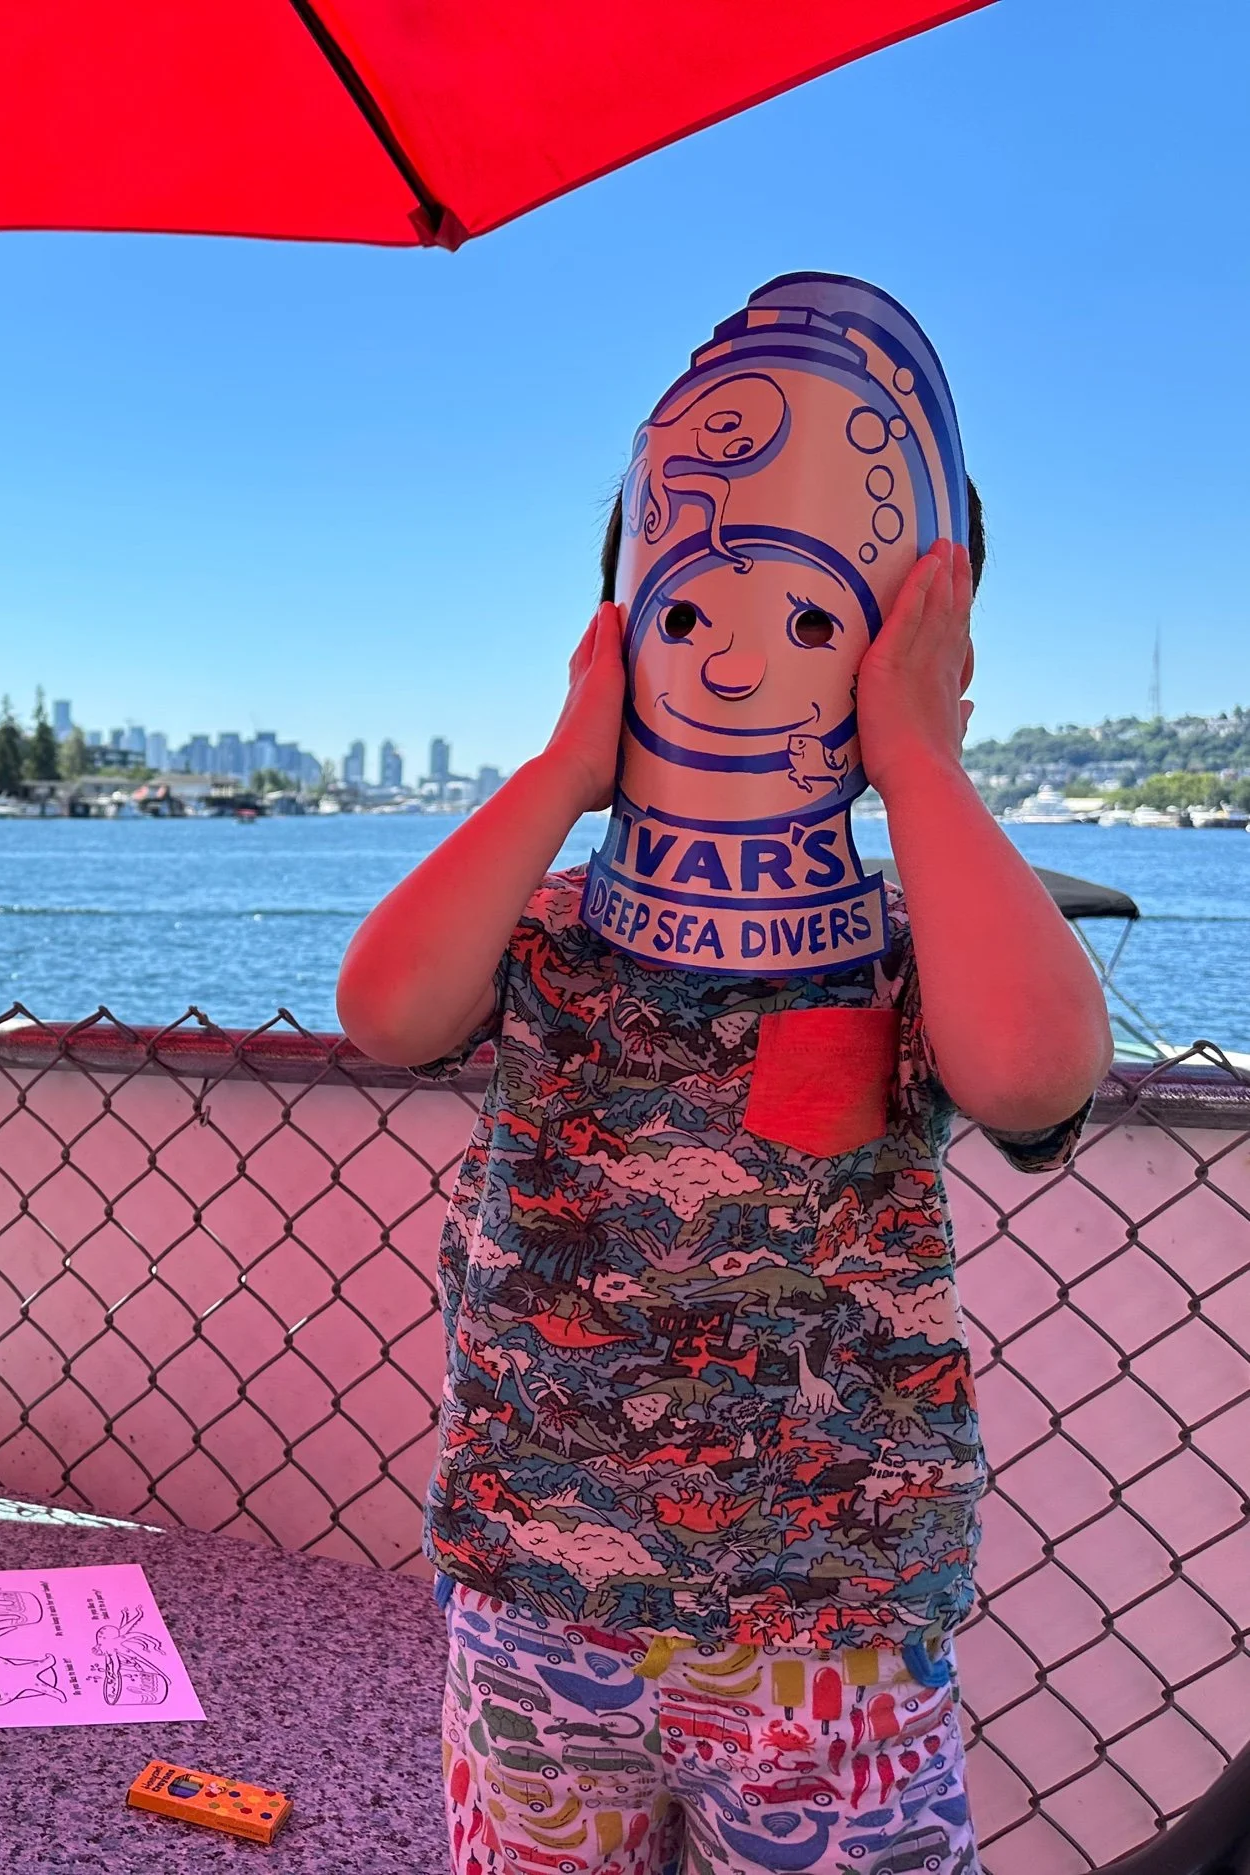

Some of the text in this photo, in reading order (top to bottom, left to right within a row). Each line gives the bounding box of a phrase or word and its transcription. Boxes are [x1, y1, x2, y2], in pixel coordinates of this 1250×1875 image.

[614, 813, 846, 892] IVAR'S
[590, 879, 871, 959] DEEP SEA DIVERS
